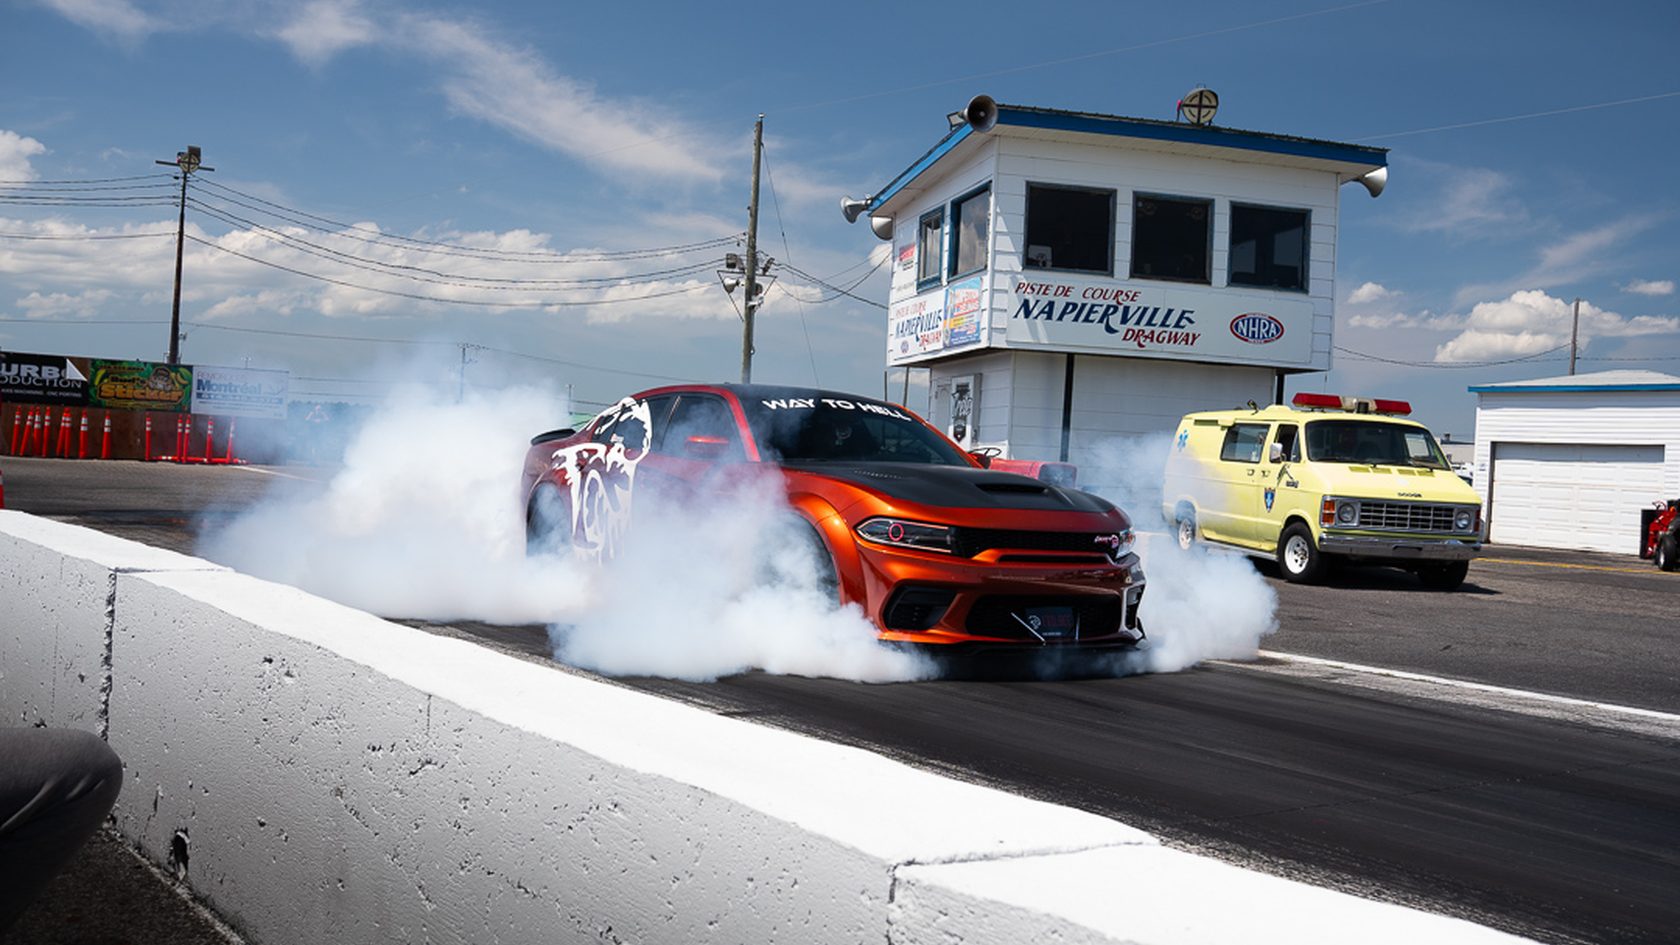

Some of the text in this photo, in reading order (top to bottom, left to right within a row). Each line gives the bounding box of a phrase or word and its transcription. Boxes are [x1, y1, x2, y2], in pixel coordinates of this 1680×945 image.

[1015, 282, 1142, 305] PISTE DE COURSE
[1013, 298, 1195, 334] NAPIERVILLE
[1122, 328, 1201, 348] DRAGWAY
[1237, 318, 1277, 339] NHRA
[99, 383, 184, 401] Sticker
[197, 379, 262, 393] Montréal
[762, 399, 912, 422] WAY TO HELL
